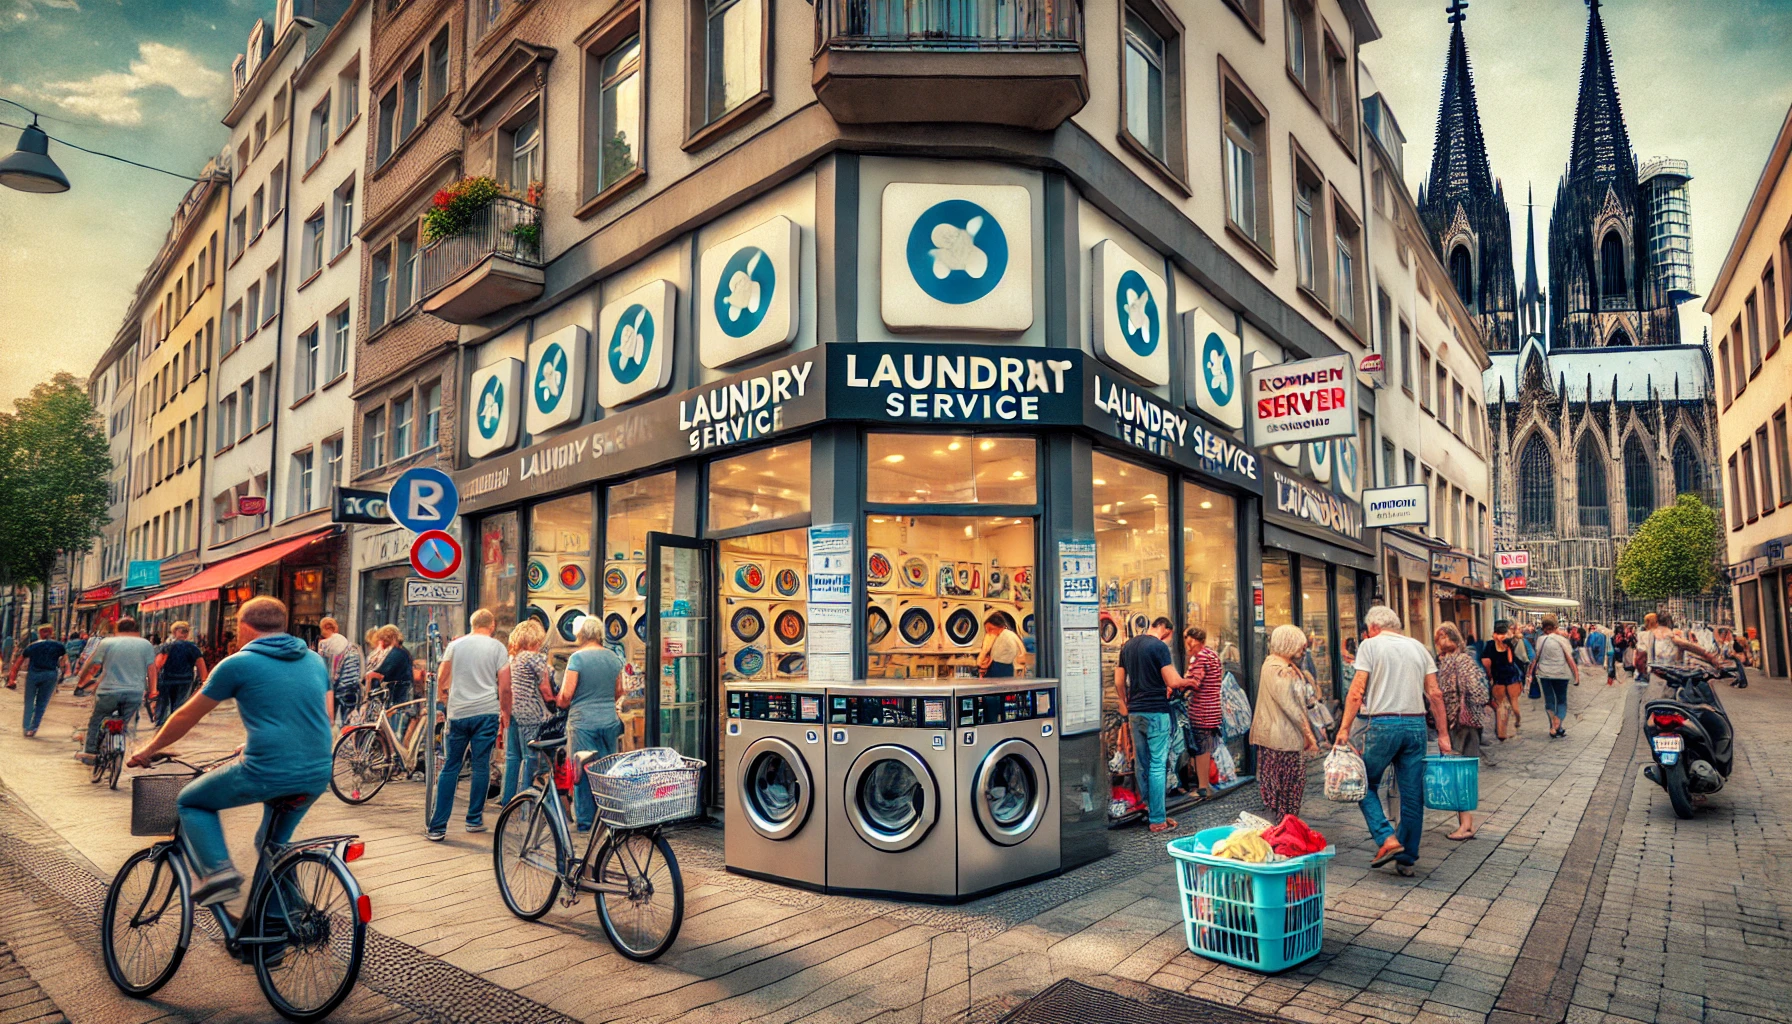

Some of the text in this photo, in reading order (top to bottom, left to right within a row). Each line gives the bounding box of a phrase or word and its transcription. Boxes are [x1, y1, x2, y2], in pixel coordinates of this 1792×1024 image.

[679, 361, 813, 431] LAUNDRY
[886, 392, 1039, 420] SERVICE
[1094, 374, 1188, 447] LAUNDRY
[1257, 387, 1345, 419] SERVER
[689, 405, 783, 452] SERVICE
